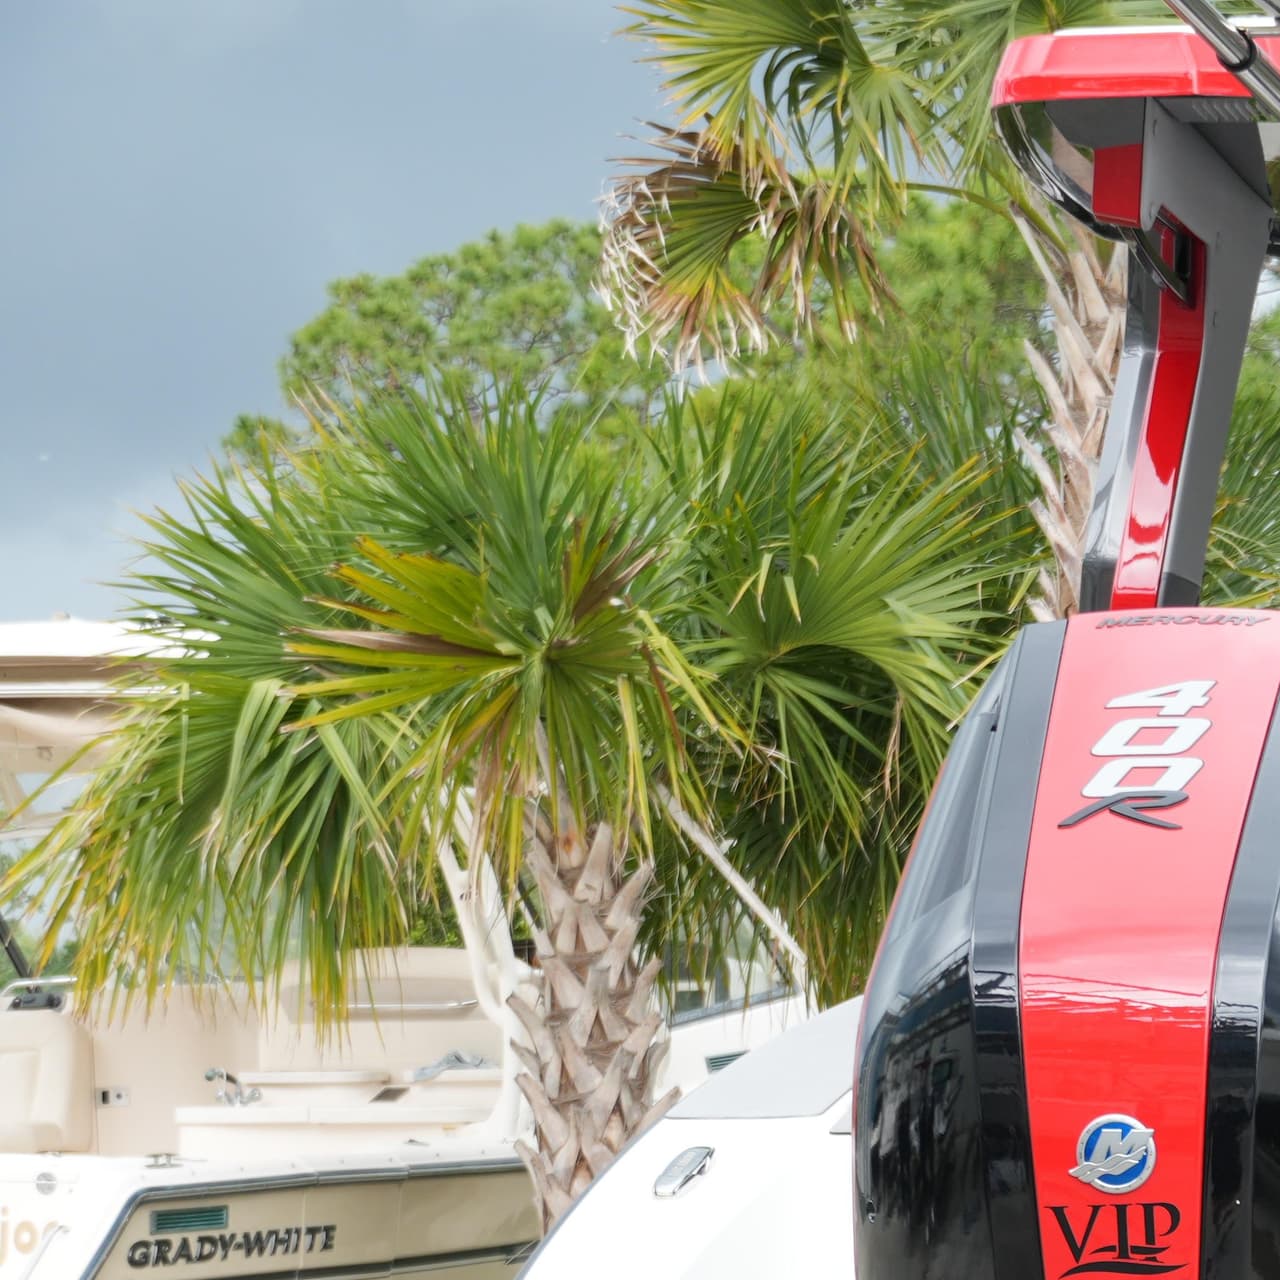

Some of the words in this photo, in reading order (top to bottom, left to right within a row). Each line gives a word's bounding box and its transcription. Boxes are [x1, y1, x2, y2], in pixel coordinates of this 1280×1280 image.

[1096, 615, 1271, 629] MERCURY
[127, 1225, 337, 1268] GRADY-WHITE
[1044, 1202, 1180, 1264] VIP
